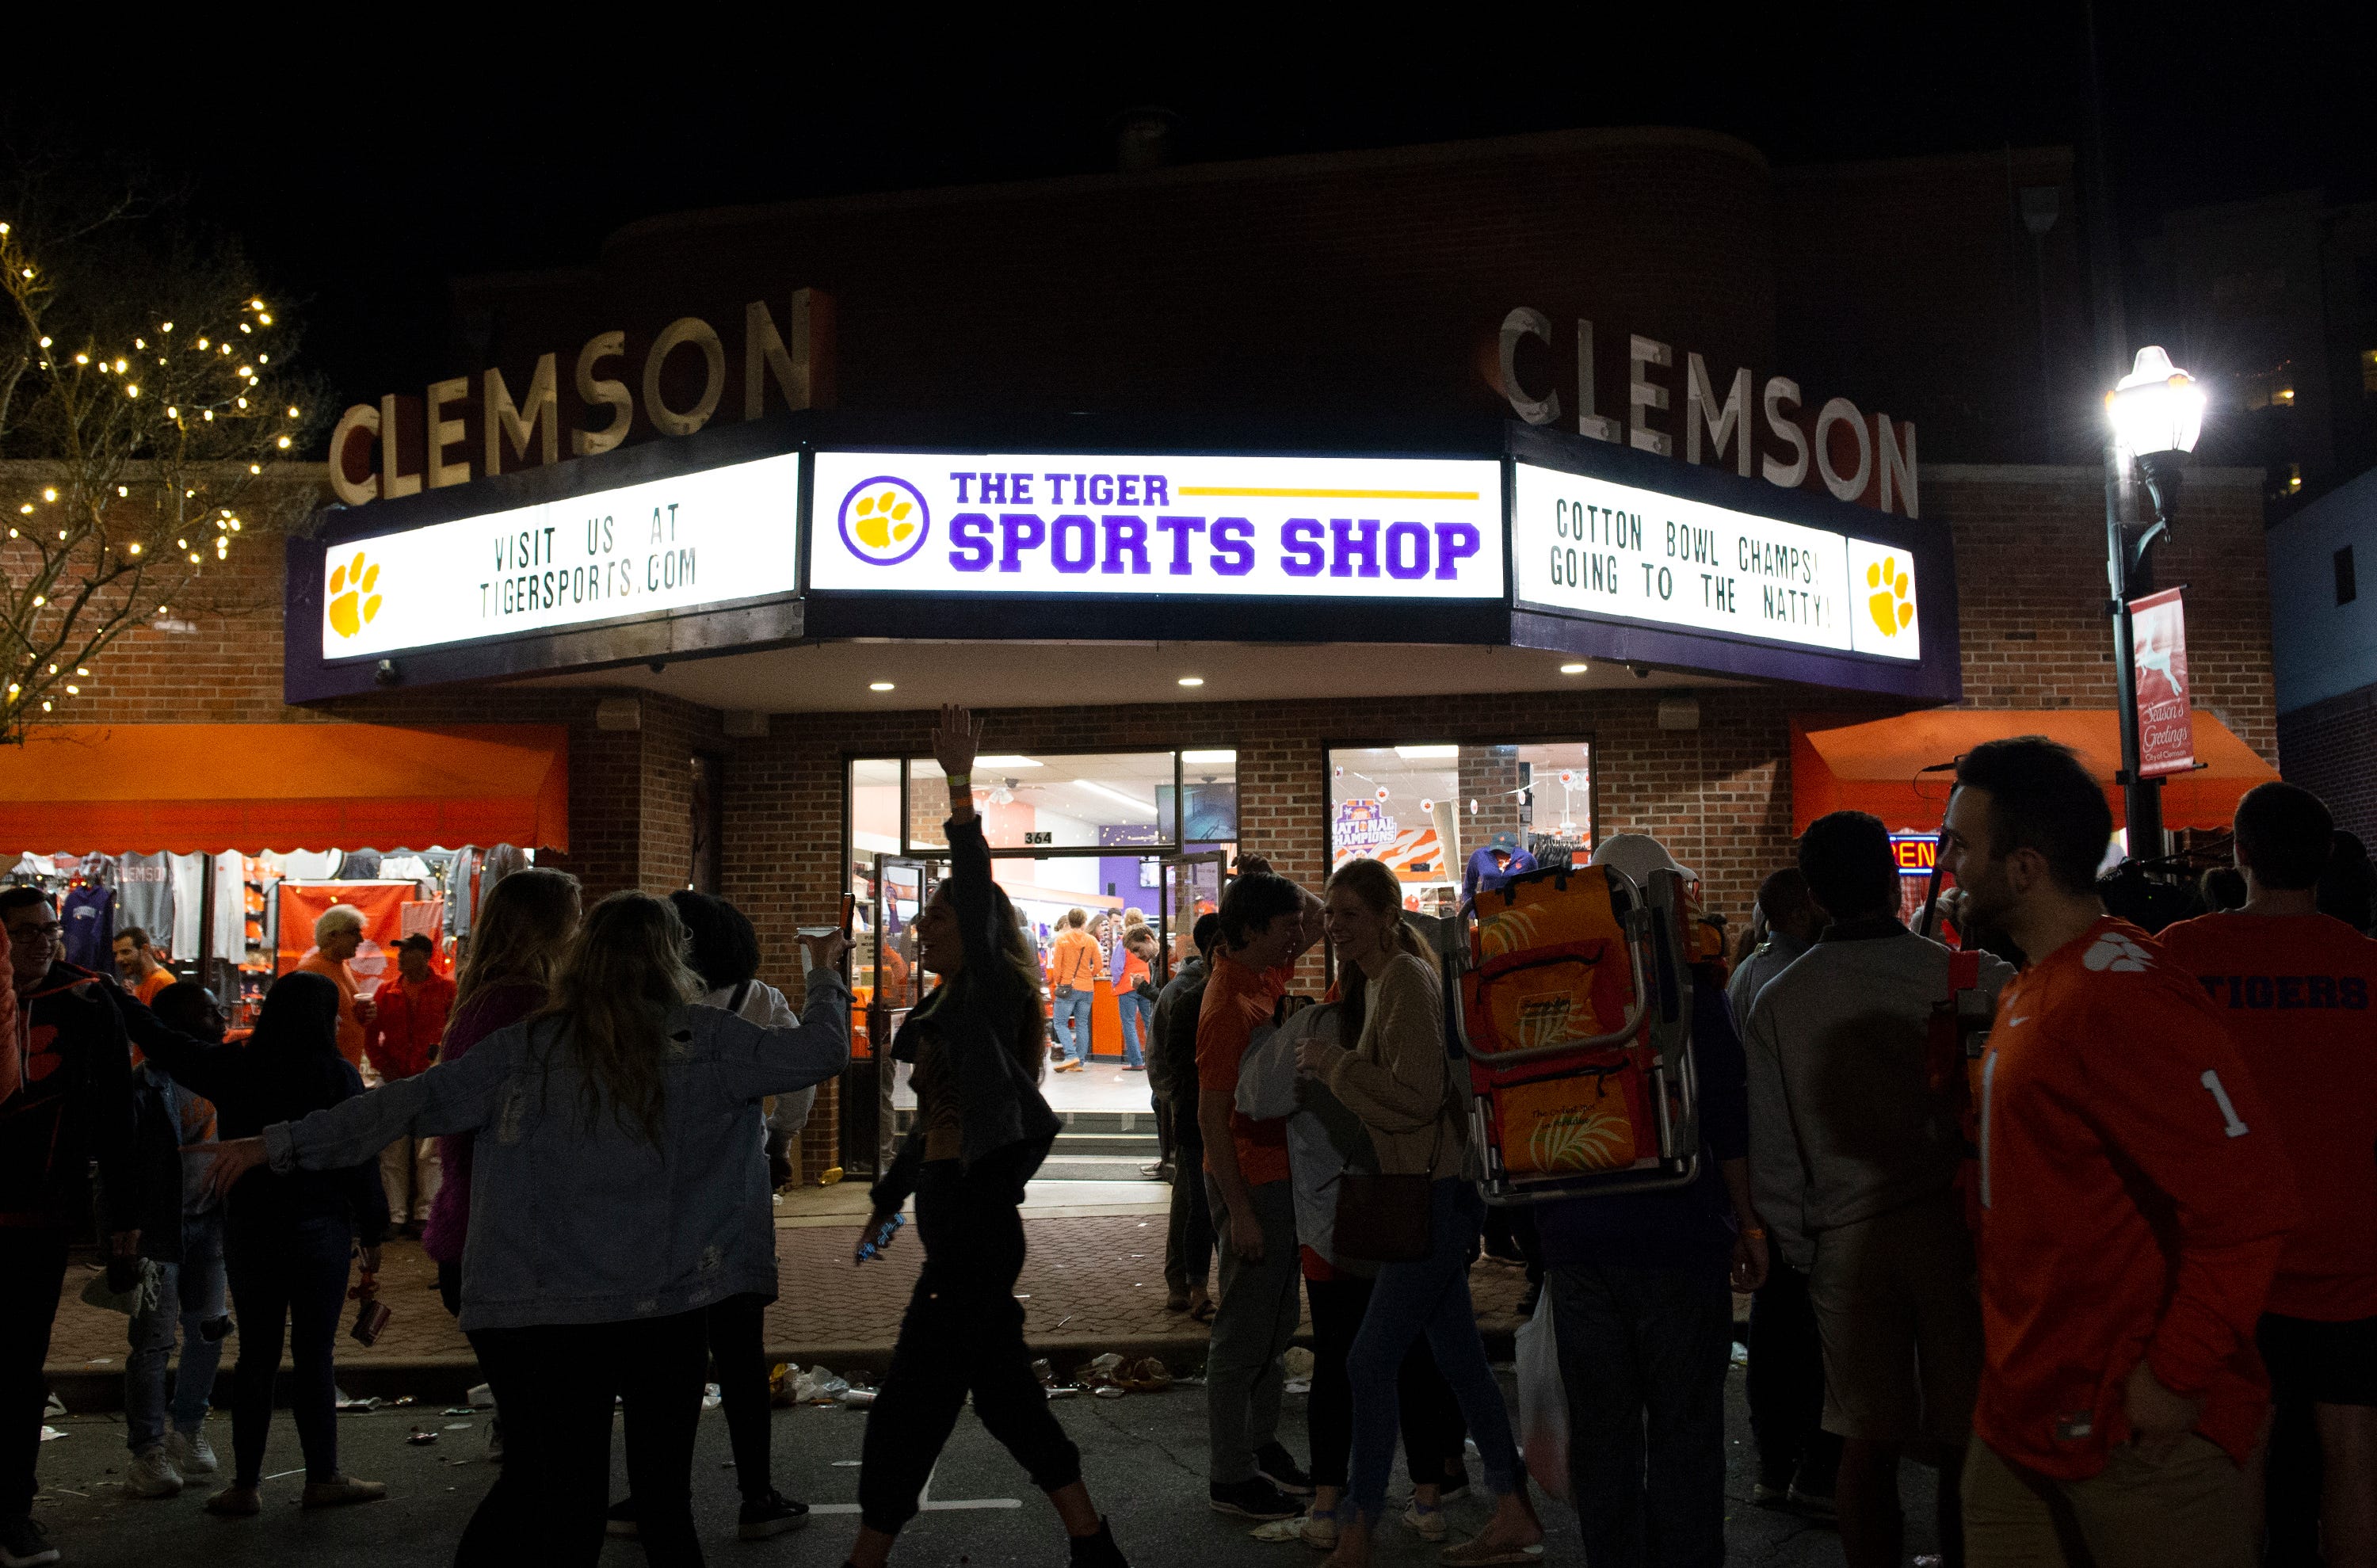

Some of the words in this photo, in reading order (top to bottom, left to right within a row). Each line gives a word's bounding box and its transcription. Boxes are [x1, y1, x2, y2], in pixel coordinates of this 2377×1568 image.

[329, 288, 811, 505] CLEMSON
[1499, 306, 1918, 519] CLEMSON
[950, 472, 1034, 505] THE
[1044, 473, 1169, 506] TIGER
[495, 526, 556, 572] VISIT
[587, 515, 614, 556] US
[650, 503, 679, 544] AT
[949, 513, 1255, 576] SPORTS
[1280, 517, 1481, 580] SHOP
[1556, 498, 1642, 552] COTTON
[1666, 520, 1719, 567] BOWL
[1738, 536, 1818, 586] CHAMPS!
[480, 547, 696, 618] TIGERSPORTS.COM
[1550, 545, 1617, 595] GOING
[1641, 562, 1673, 601] TO
[1700, 573, 1736, 614] THE
[1763, 584, 1831, 628] NATTY!
[2142, 702, 2184, 724] Season's
[2142, 724, 2188, 753] Greetings
[1024, 832, 1052, 845] 364
[1332, 831, 1395, 846] HAMPIONS
[1891, 842, 1936, 868] EN
[115, 865, 167, 883] CLEMSO
[2200, 1069, 2249, 1138] 1
